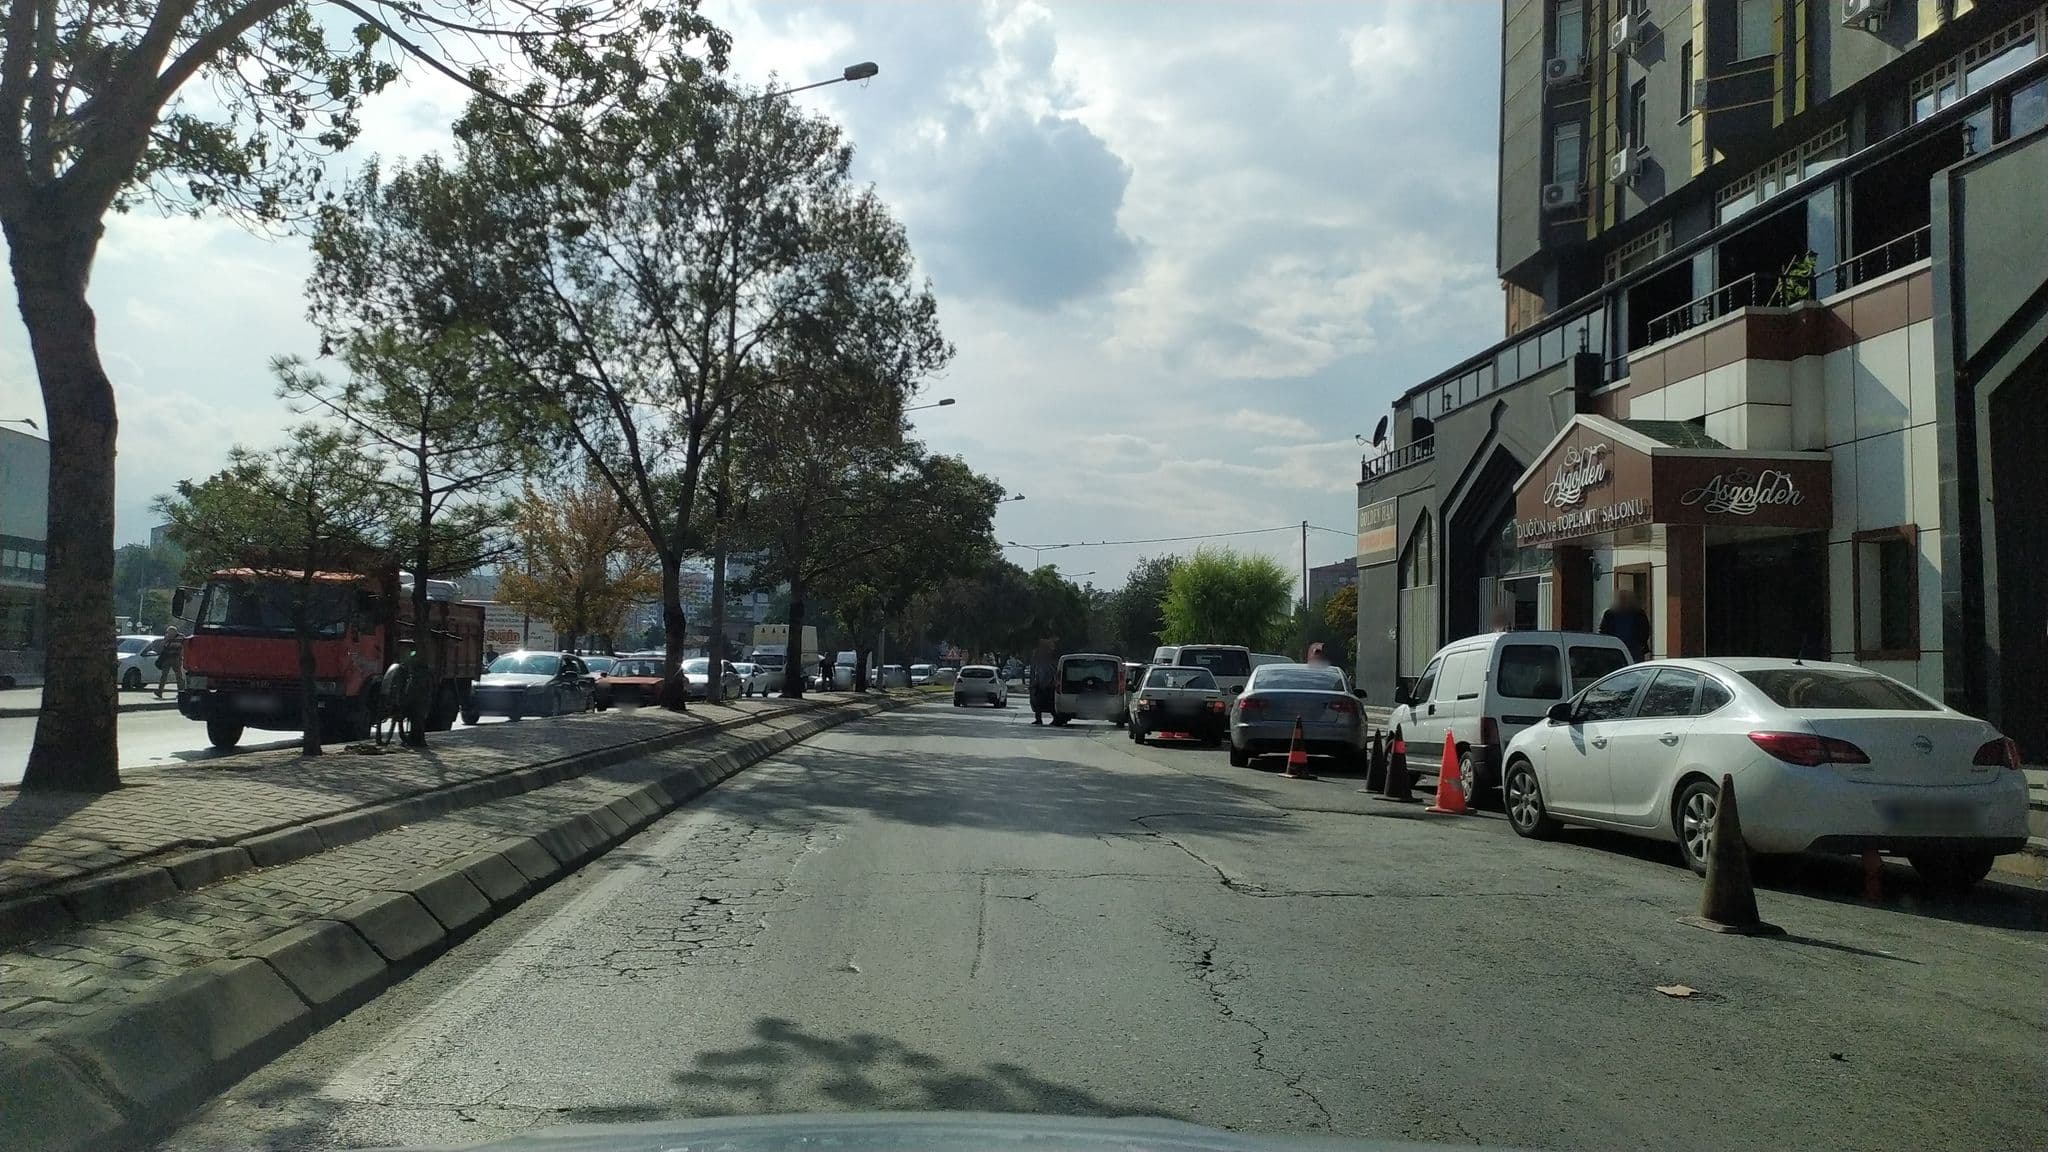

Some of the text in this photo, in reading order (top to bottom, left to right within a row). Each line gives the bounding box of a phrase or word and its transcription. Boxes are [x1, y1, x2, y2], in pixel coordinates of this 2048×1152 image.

[1543, 443, 1606, 507] Asgolden
[1680, 467, 1804, 515] Asgolden
[1547, 520, 1557, 532] ve
[1602, 498, 1644, 522] SALONU
